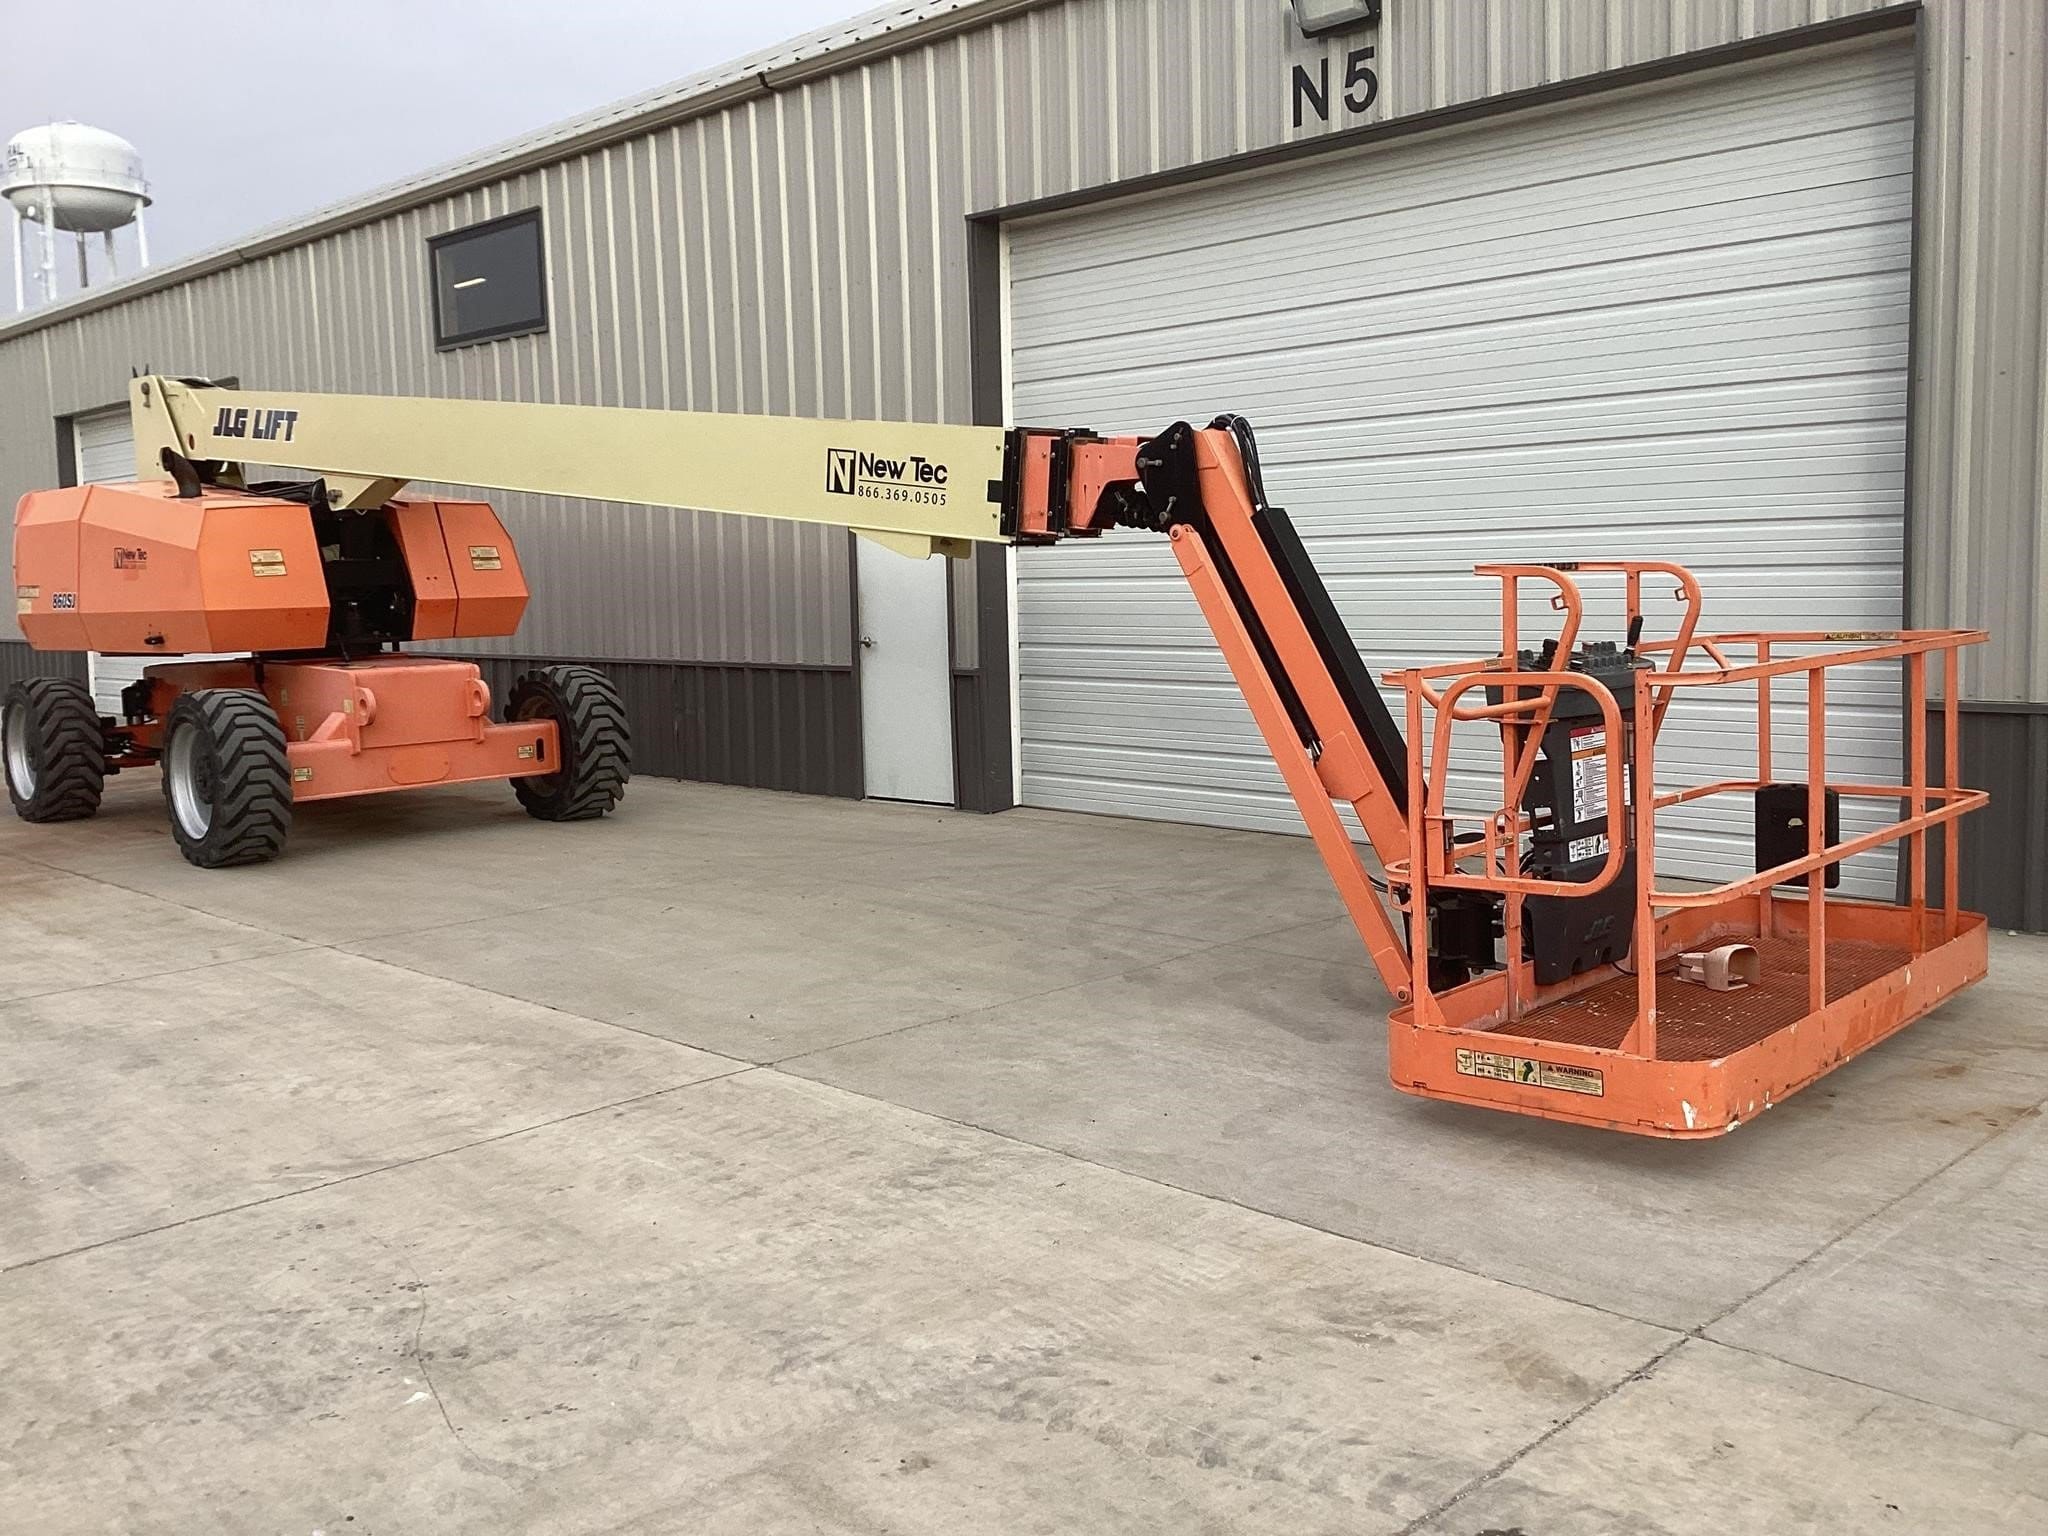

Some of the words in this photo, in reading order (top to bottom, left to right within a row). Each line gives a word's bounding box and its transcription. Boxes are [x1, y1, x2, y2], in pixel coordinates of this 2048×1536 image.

[212, 407, 249, 438] JLG
[252, 409, 299, 442] LIFT
[858, 452, 906, 480] New
[910, 456, 948, 484] Tec
[858, 485, 946, 506] 866.369.0505
[1556, 1065, 1594, 1078] WARNING
